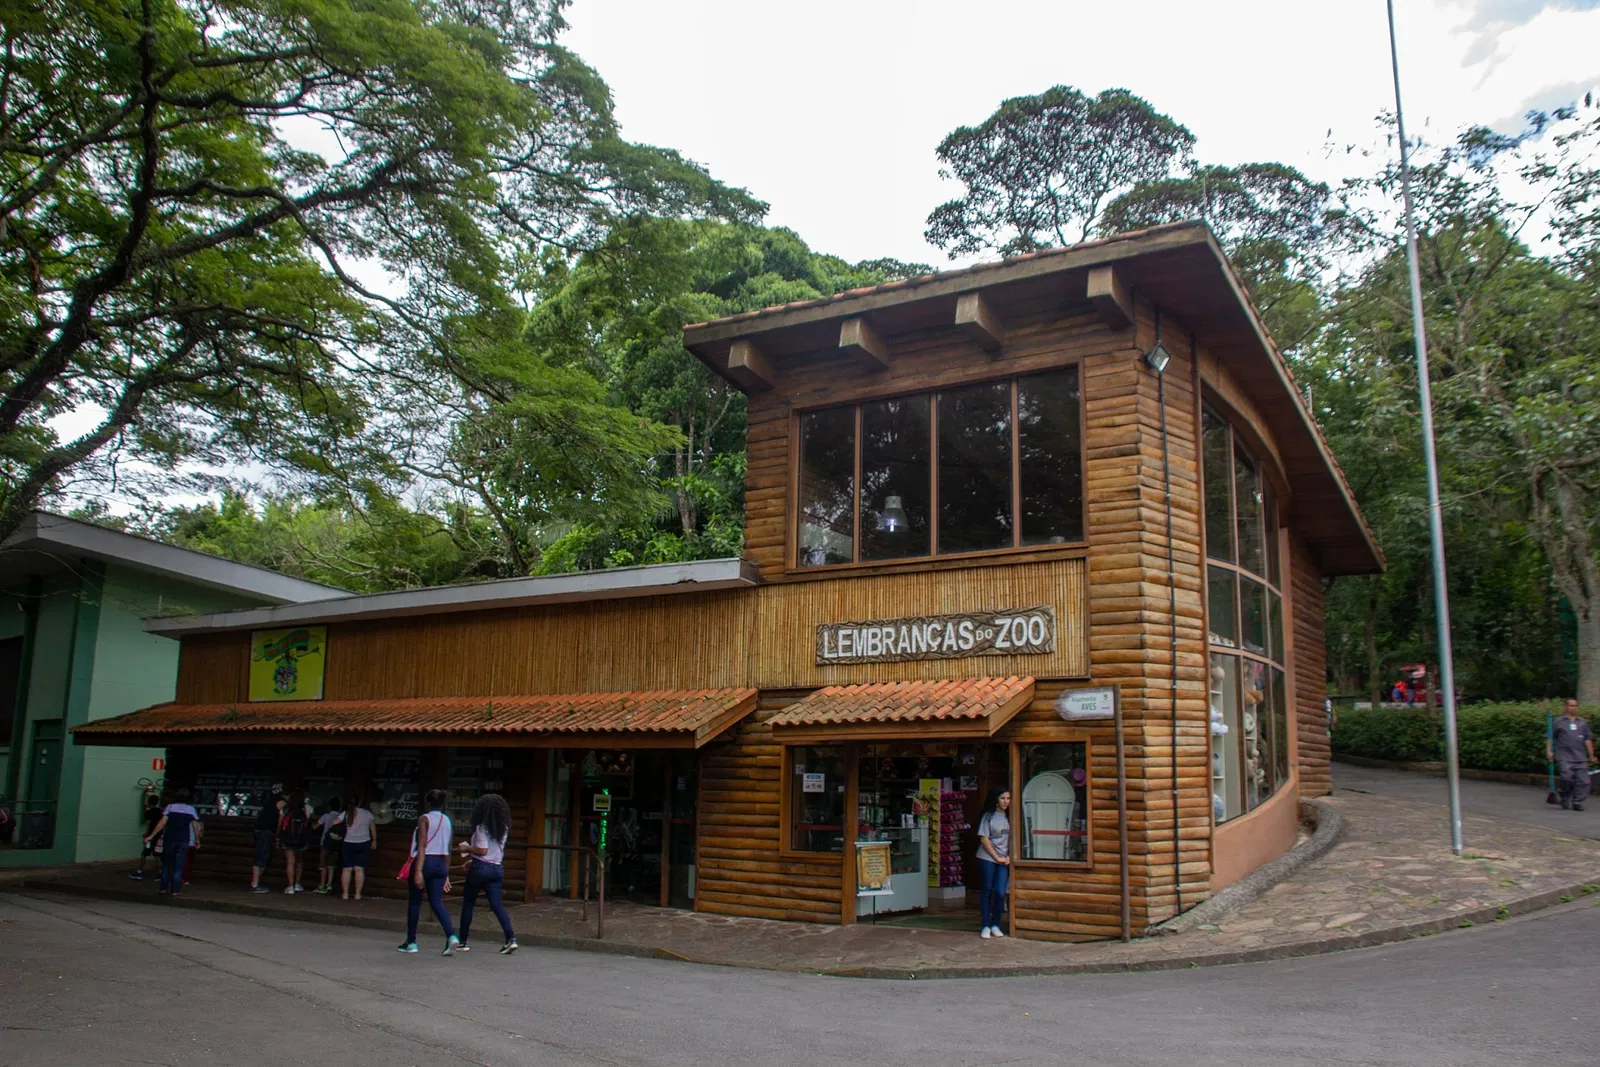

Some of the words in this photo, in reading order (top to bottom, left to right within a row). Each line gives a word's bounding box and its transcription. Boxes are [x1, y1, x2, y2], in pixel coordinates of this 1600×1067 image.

[824, 621, 974, 658] LEMBRANÇAS
[975, 629, 993, 641] DO
[995, 615, 1045, 648] ZOO
[1081, 703, 1097, 711] AVES
